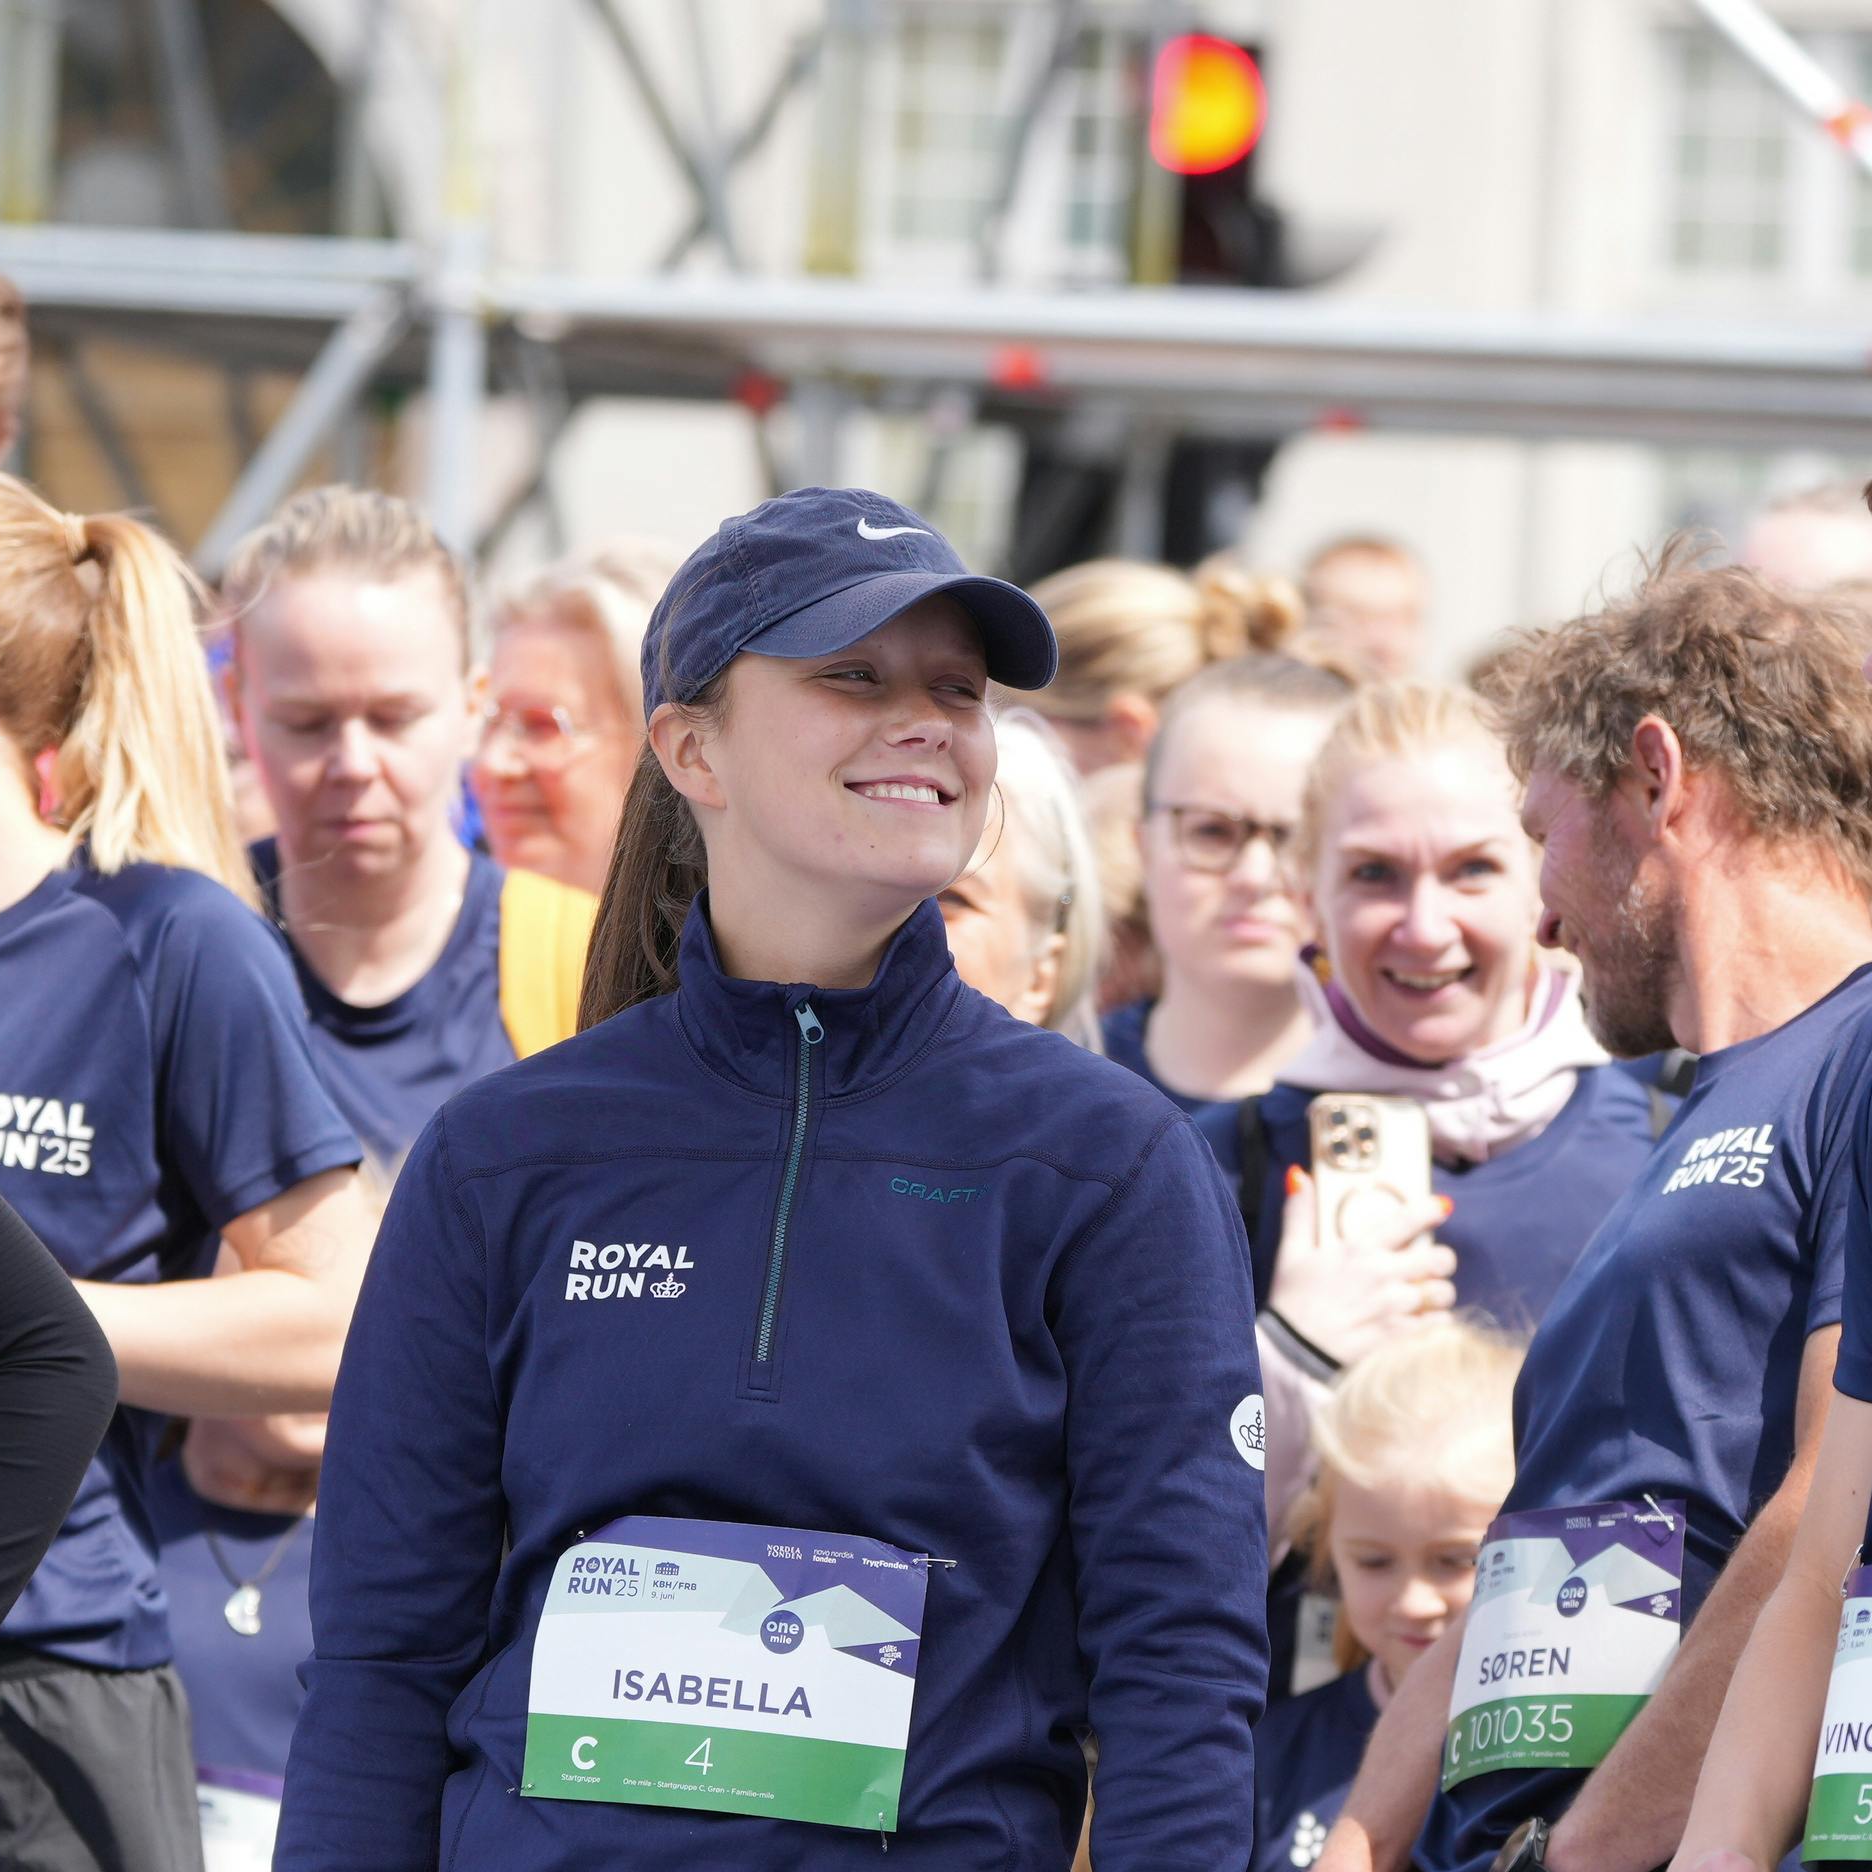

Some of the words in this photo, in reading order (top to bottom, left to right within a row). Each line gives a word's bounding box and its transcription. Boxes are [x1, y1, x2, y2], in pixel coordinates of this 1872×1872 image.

[1681, 1124, 1775, 1165] ROYAL
[891, 1177, 977, 1204] CRAFT
[569, 1240, 695, 1271] ROYAL
[564, 1272, 646, 1301] RUN
[767, 1544, 801, 1553] NORDEA
[768, 1551, 802, 1560] FONDEN
[572, 1557, 640, 1576] ROYAL
[812, 1555, 837, 1564] fonden
[862, 1557, 909, 1570] TrygFonden
[652, 1580, 697, 1591] KBH/FRB
[660, 1592, 675, 1601] juni
[1560, 1586, 1585, 1600] one
[1562, 1599, 1580, 1608] mile
[766, 1620, 800, 1635] one
[769, 1634, 792, 1645] mile
[1478, 1647, 1571, 1685] SØREN
[612, 1668, 813, 1719] ISABELLA
[1451, 1731, 1462, 1765] C
[1469, 1704, 1573, 1752] 101035
[571, 1736, 599, 1770] C
[684, 1737, 713, 1776] 4
[561, 1773, 601, 1783] Startgruppe
[623, 1777, 636, 1786] One
[637, 1779, 651, 1787] mile
[657, 1780, 698, 1791] Startgruppe
